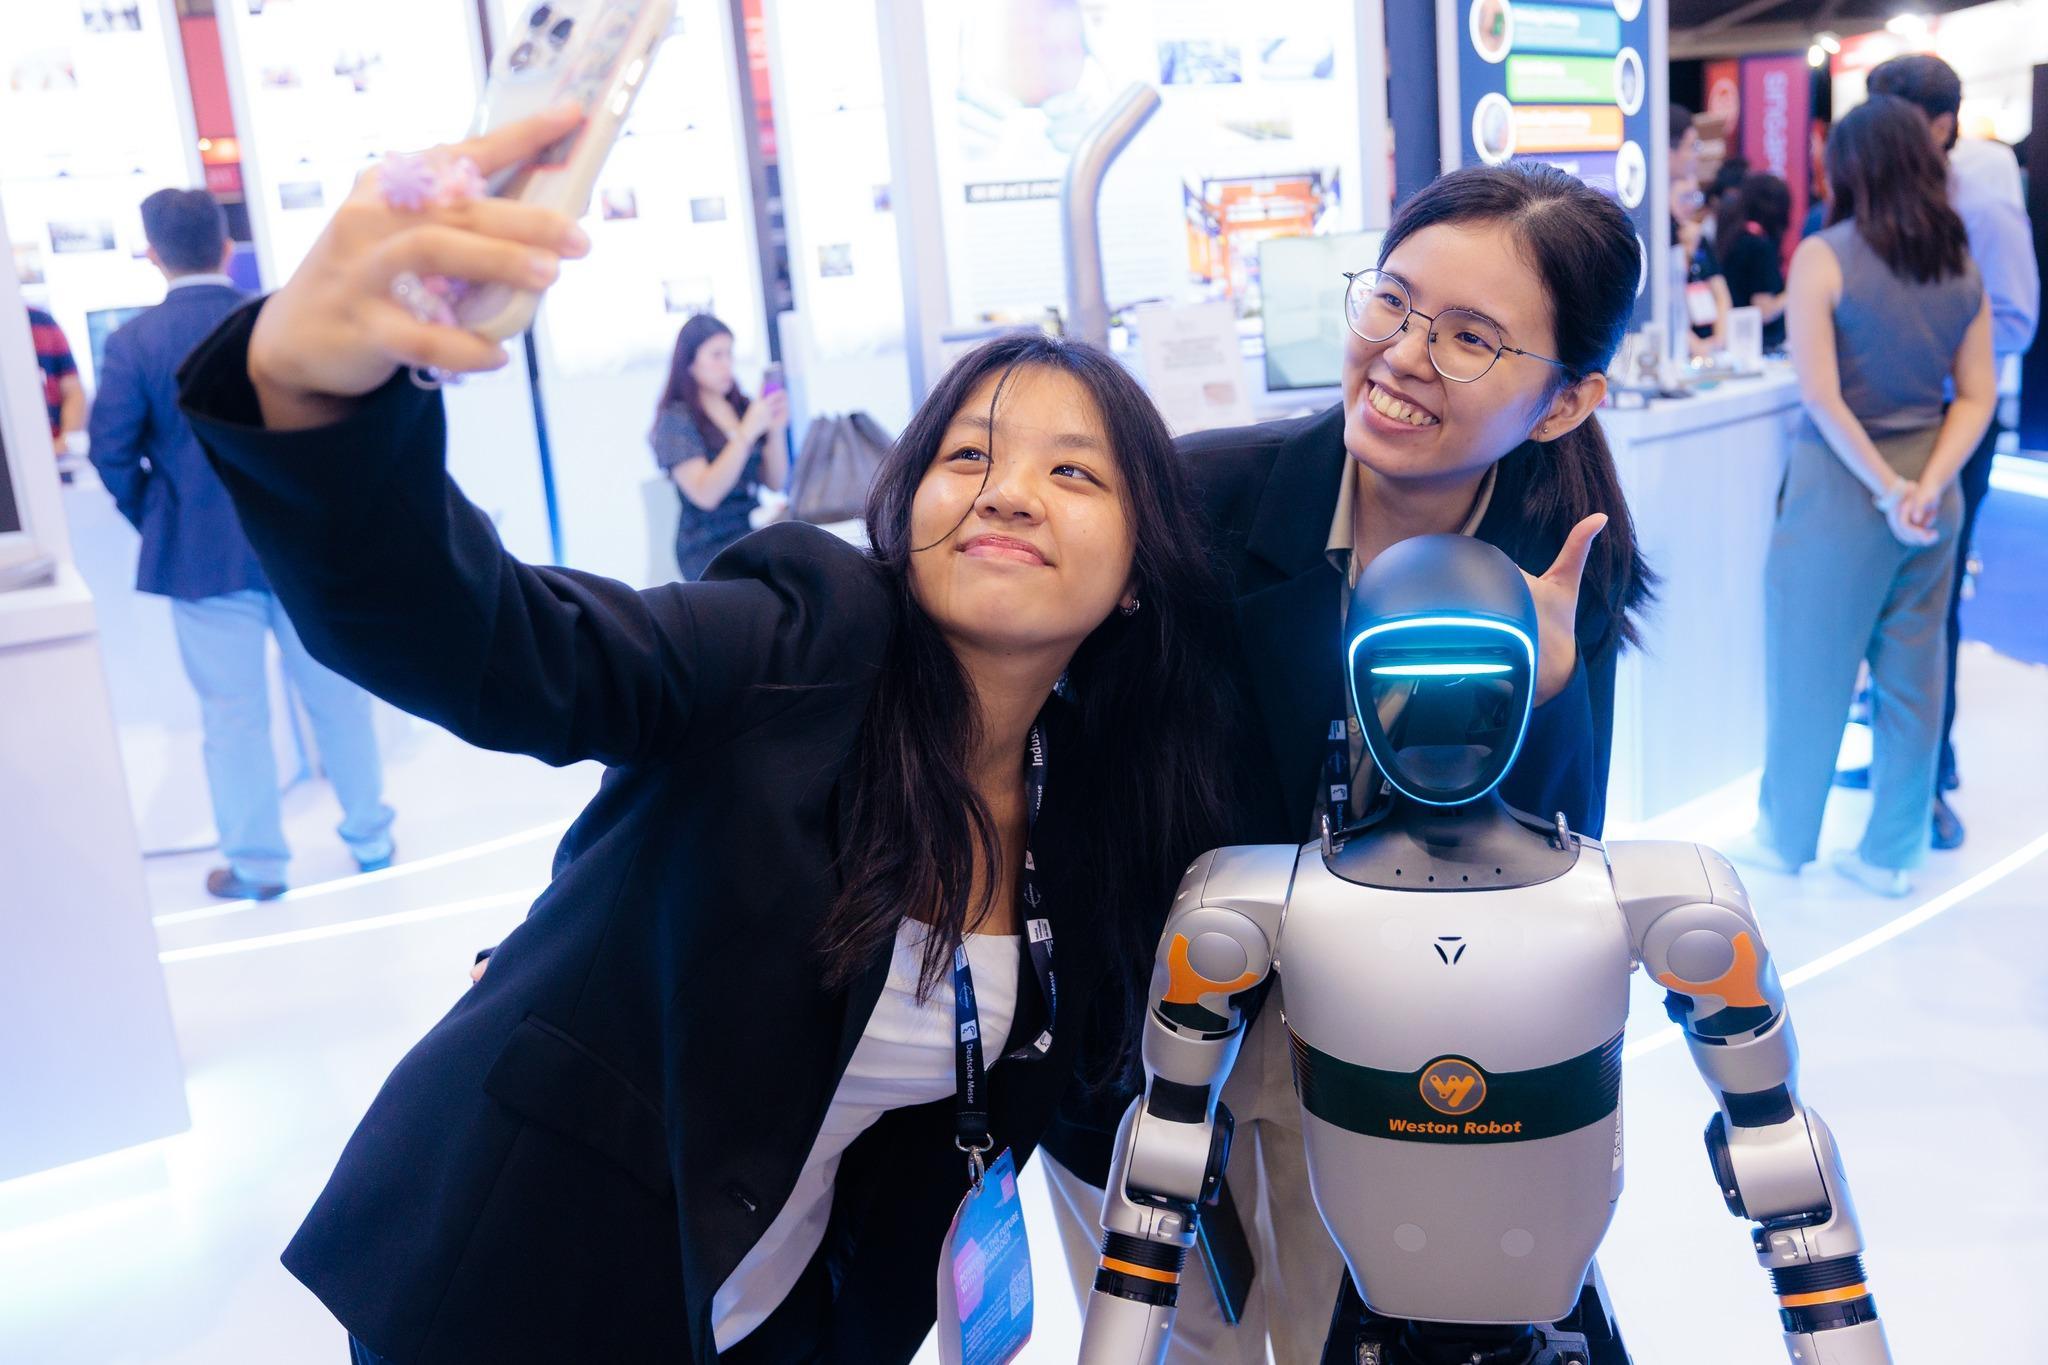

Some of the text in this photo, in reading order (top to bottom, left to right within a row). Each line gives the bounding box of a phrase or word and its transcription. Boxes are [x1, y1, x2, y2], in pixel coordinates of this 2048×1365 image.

[966, 1044, 974, 1077] Deutsche
[1389, 1119, 1522, 1134] Weston Robot
